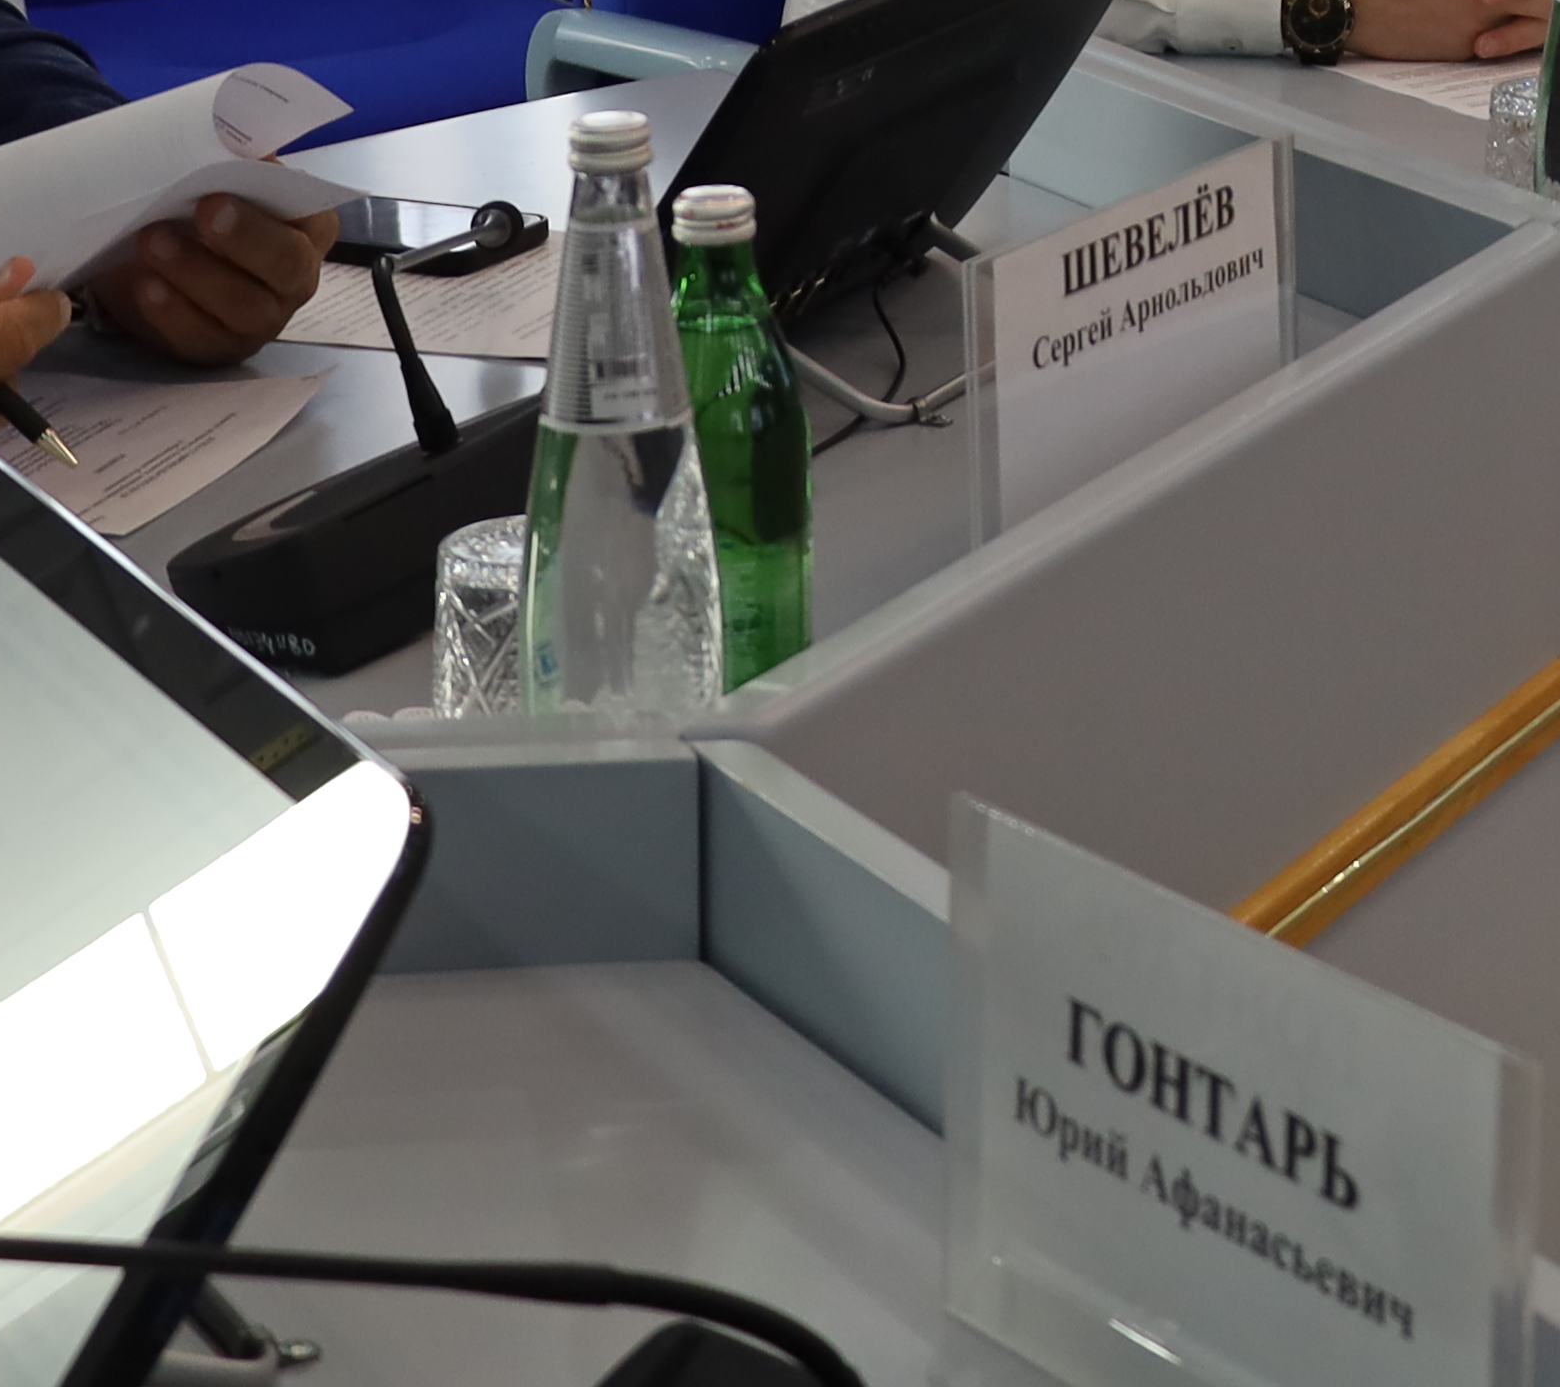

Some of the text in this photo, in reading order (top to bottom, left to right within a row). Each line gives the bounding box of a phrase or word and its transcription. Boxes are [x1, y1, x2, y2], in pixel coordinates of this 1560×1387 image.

[1031, 246, 1266, 371] Сергей Арнольдович
[1061, 184, 1237, 298] ШЕВЕЛЁВ
[1066, 994, 1362, 1212] ГОНТАРЬ
[1013, 1076, 1414, 1341] Юрий Афанасьевич
